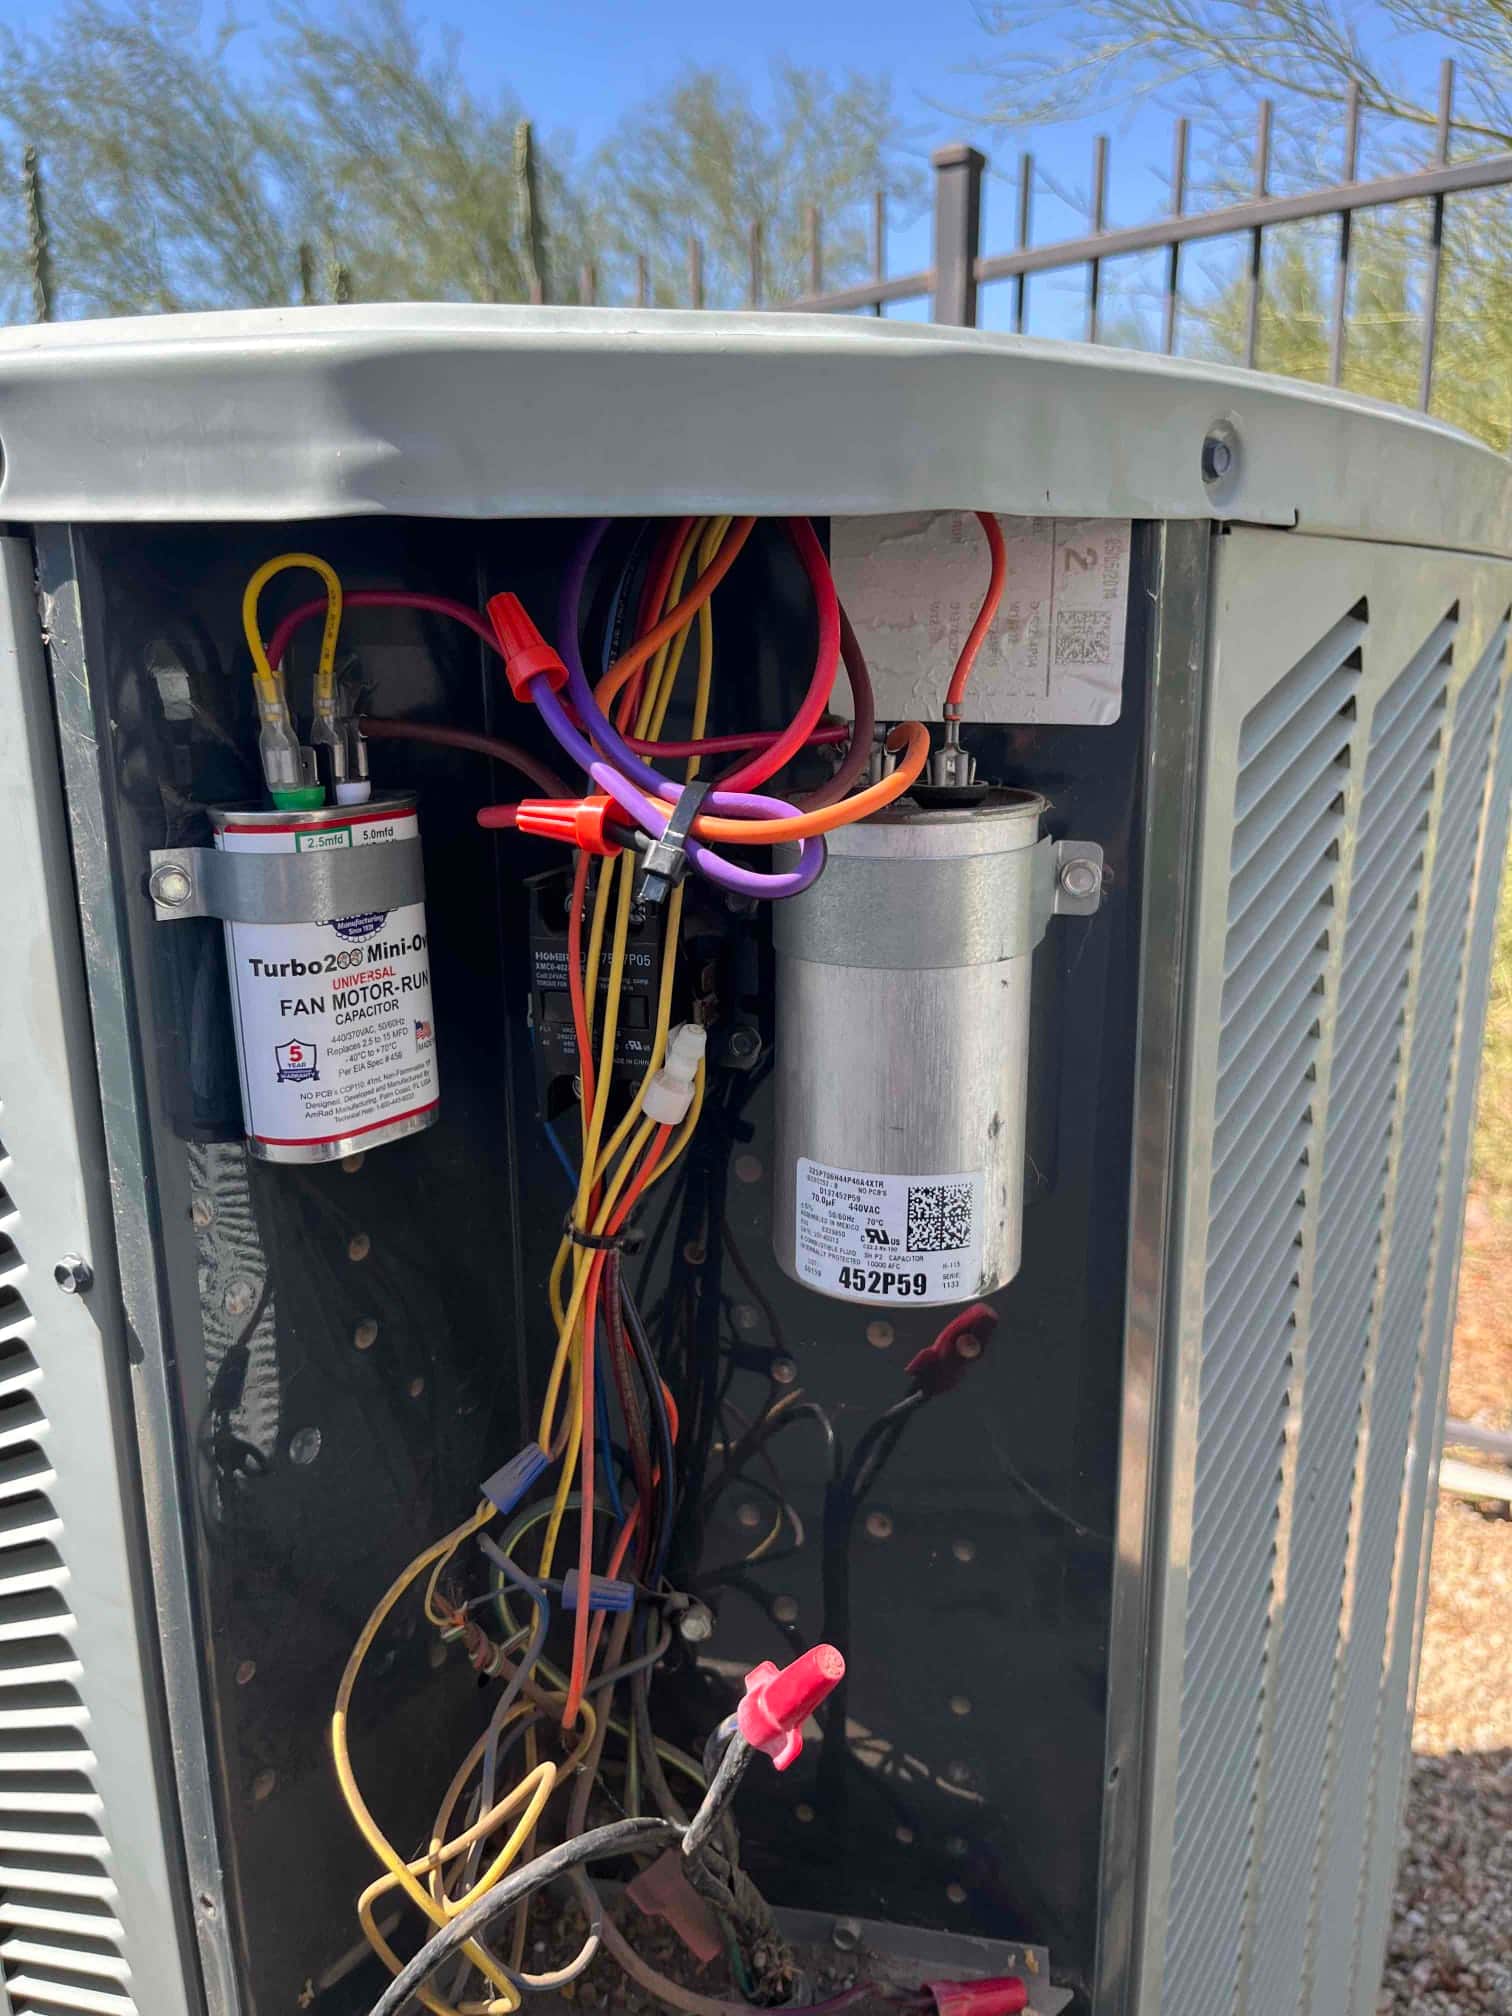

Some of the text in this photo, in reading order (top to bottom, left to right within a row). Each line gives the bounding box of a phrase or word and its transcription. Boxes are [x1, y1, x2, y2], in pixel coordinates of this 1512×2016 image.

[1064, 548, 1097, 572] 2
[363, 826, 394, 840] 5.0mfd
[307, 833, 344, 849] 2.5mfd
[332, 966, 397, 990] UNIVERSAL
[280, 970, 429, 1017] FAN MOTOR-RUN
[335, 999, 400, 1025] CAPACITOR
[326, 1042, 361, 1057] Replaces
[391, 1027, 409, 1038] MFD
[289, 1045, 304, 1062] 5
[367, 1048, 375, 1057] to
[338, 1067, 351, 1077] Per
[353, 1062, 366, 1073] EIA
[366, 1058, 384, 1069] Spec
[300, 1092, 314, 1101] NO
[305, 1109, 334, 1119] AmRad
[848, 1202, 880, 1215] 440VAC
[836, 1221, 860, 1231] MEXICO
[867, 1218, 884, 1227] 70°C
[828, 1252, 861, 1265] PROTECTED
[839, 1247, 857, 1257] FLUID
[889, 1254, 924, 1263] CAPACITOR
[887, 1262, 901, 1270] AFC
[838, 1266, 928, 1296] 452P59
